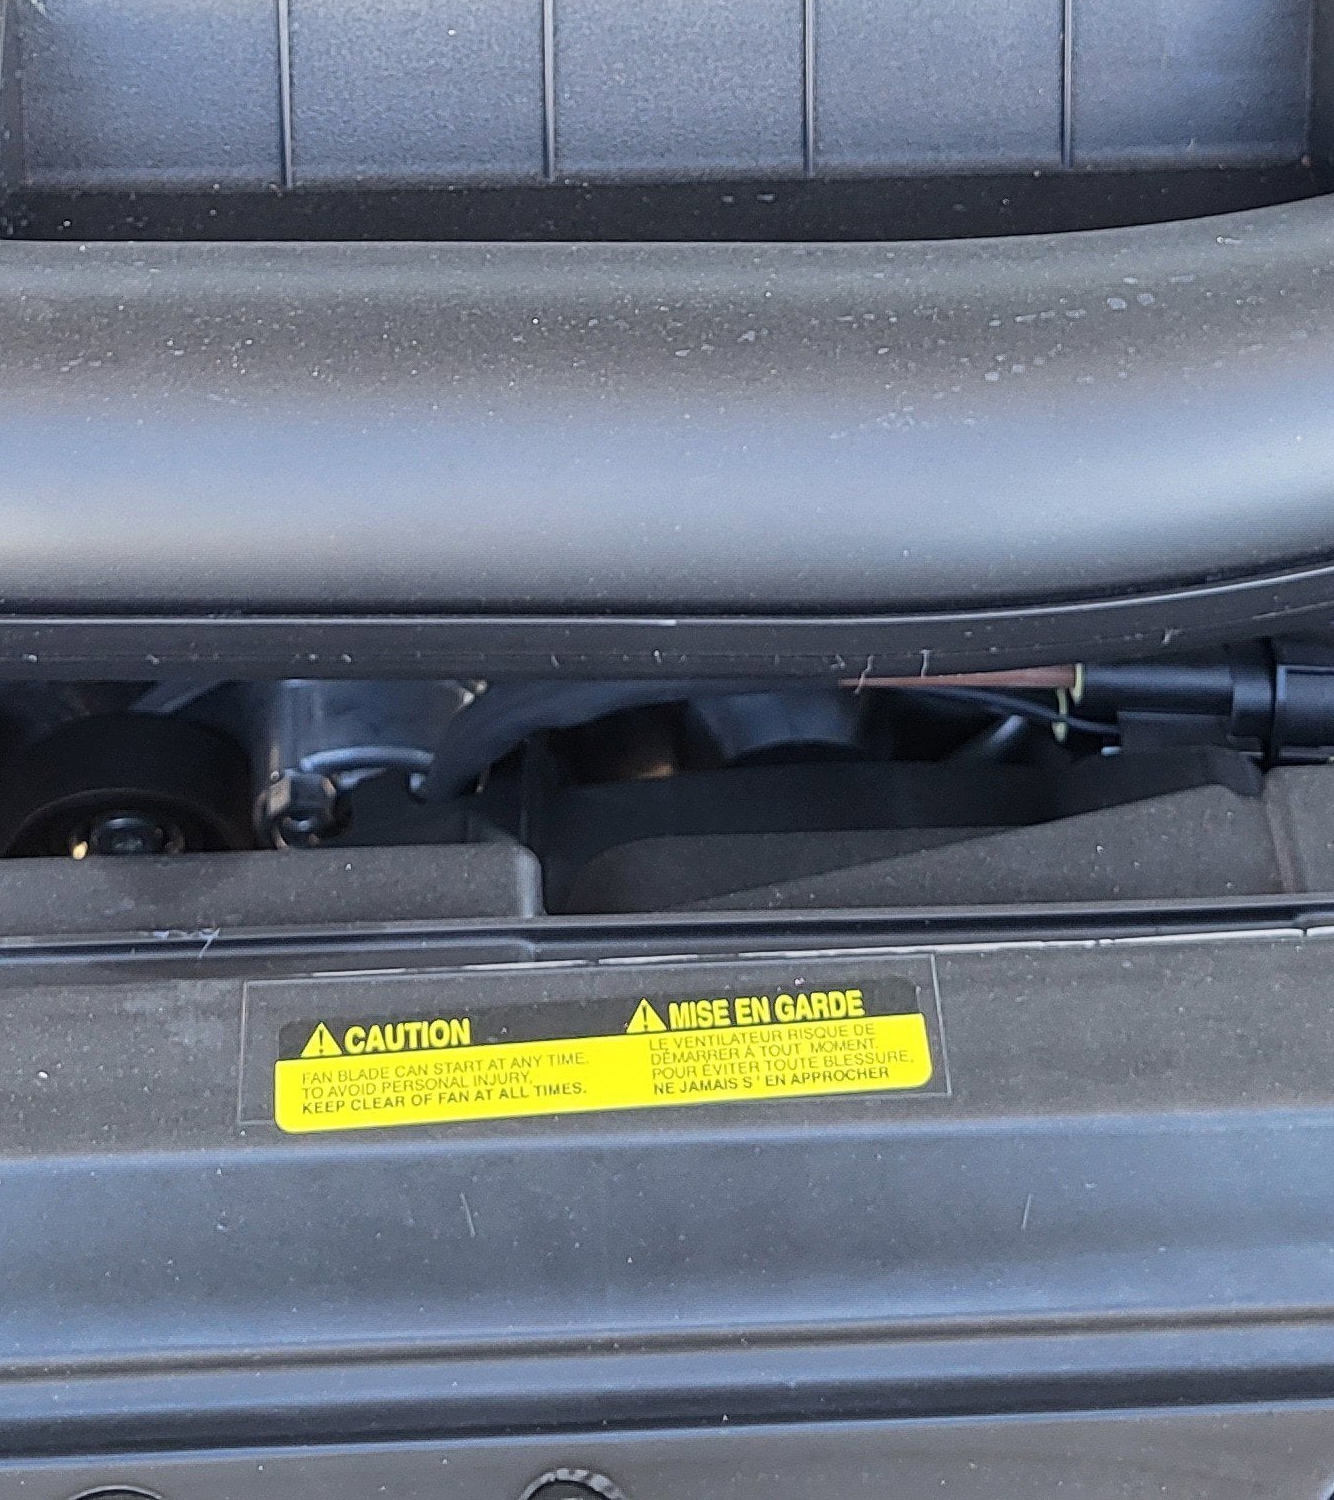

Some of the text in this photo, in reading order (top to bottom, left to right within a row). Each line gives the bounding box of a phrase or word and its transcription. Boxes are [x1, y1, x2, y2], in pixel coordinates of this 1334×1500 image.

[668, 989, 865, 1031] MISE EN GARDE
[344, 1018, 471, 1054] CAUTION
[650, 1023, 875, 1051] LE VENTILATEUR RISQUE DE
[761, 1043, 801, 1058] TOUT
[302, 1071, 332, 1085] FAN
[339, 1067, 389, 1082] BLADE
[395, 1064, 428, 1079] CAN
[434, 1060, 482, 1075] START
[487, 1058, 508, 1071] AT
[510, 1056, 542, 1069] ANY
[653, 1066, 697, 1079] POUR
[764, 1058, 817, 1073] TOUTE
[653, 1082, 676, 1095] NE
[679, 1077, 739, 1092] JAMAIS
[766, 1073, 786, 1086] EN
[791, 1067, 889, 1084] APPROCHER
[302, 1087, 324, 1100] TO
[330, 1082, 377, 1098] AVOID
[382, 1076, 468, 1094] PERSONAL
[303, 1082, 587, 1115] KEEP CLEAR OF FAN AT ALL TIMES.
